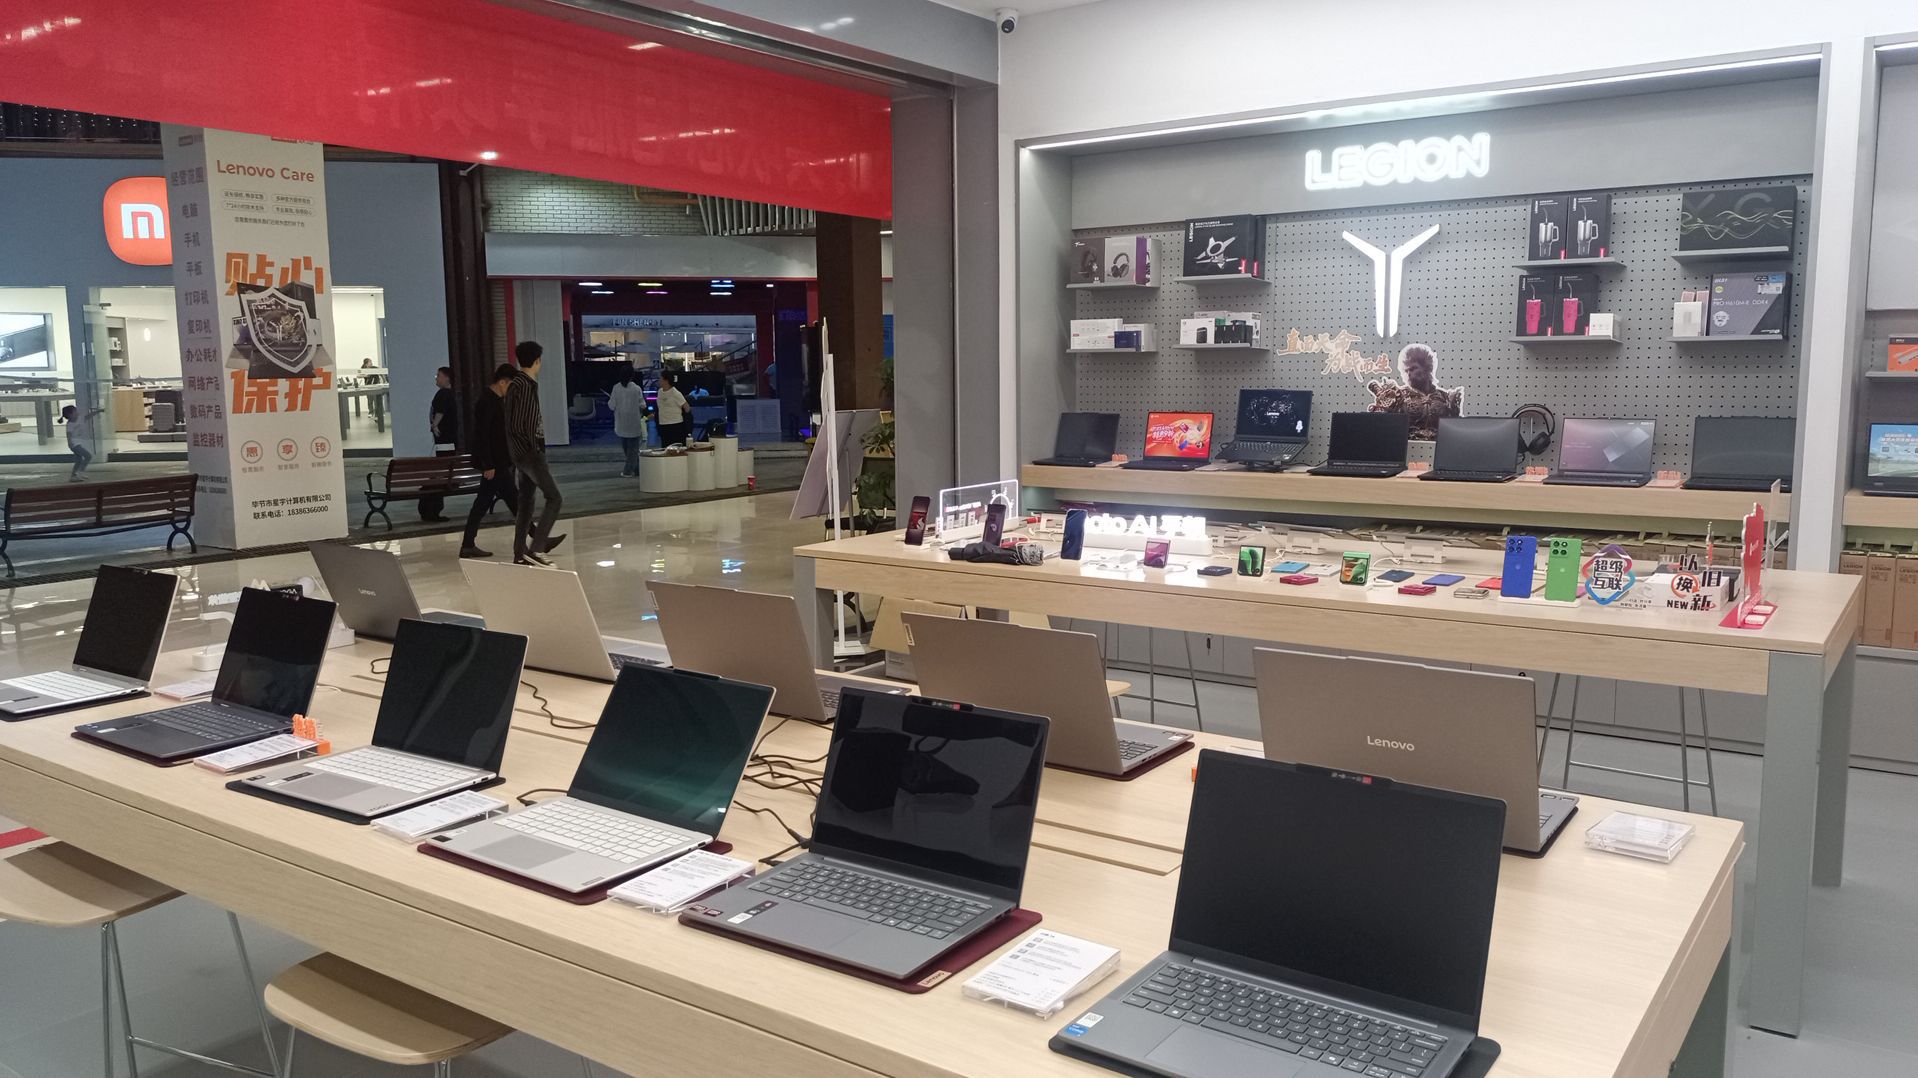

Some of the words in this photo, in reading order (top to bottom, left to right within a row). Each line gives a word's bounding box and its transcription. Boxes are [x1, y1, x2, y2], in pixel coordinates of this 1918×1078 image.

[1305, 132, 1491, 190] LEGION
[216, 160, 276, 179] Lenovo
[280, 167, 315, 183] Care
[184, 232, 201, 248] 手机
[186, 261, 203, 277] 平板
[225, 252, 324, 296] 贴心
[185, 290, 210, 307] 打印机
[187, 319, 212, 336] 复印机
[230, 367, 332, 414] 保护
[190, 404, 223, 420] 数码产品
[193, 433, 224, 449] 监控器材
[1594, 559, 1624, 573] 超级
[1679, 554, 1698, 571] 以
[1592, 576, 1623, 591] 互联
[1676, 576, 1693, 593] 换
[1701, 570, 1722, 588] 旧
[1667, 599, 1689, 610] NEW
[1690, 594, 1713, 612] 新
[1367, 735, 1415, 752] Lenovo
